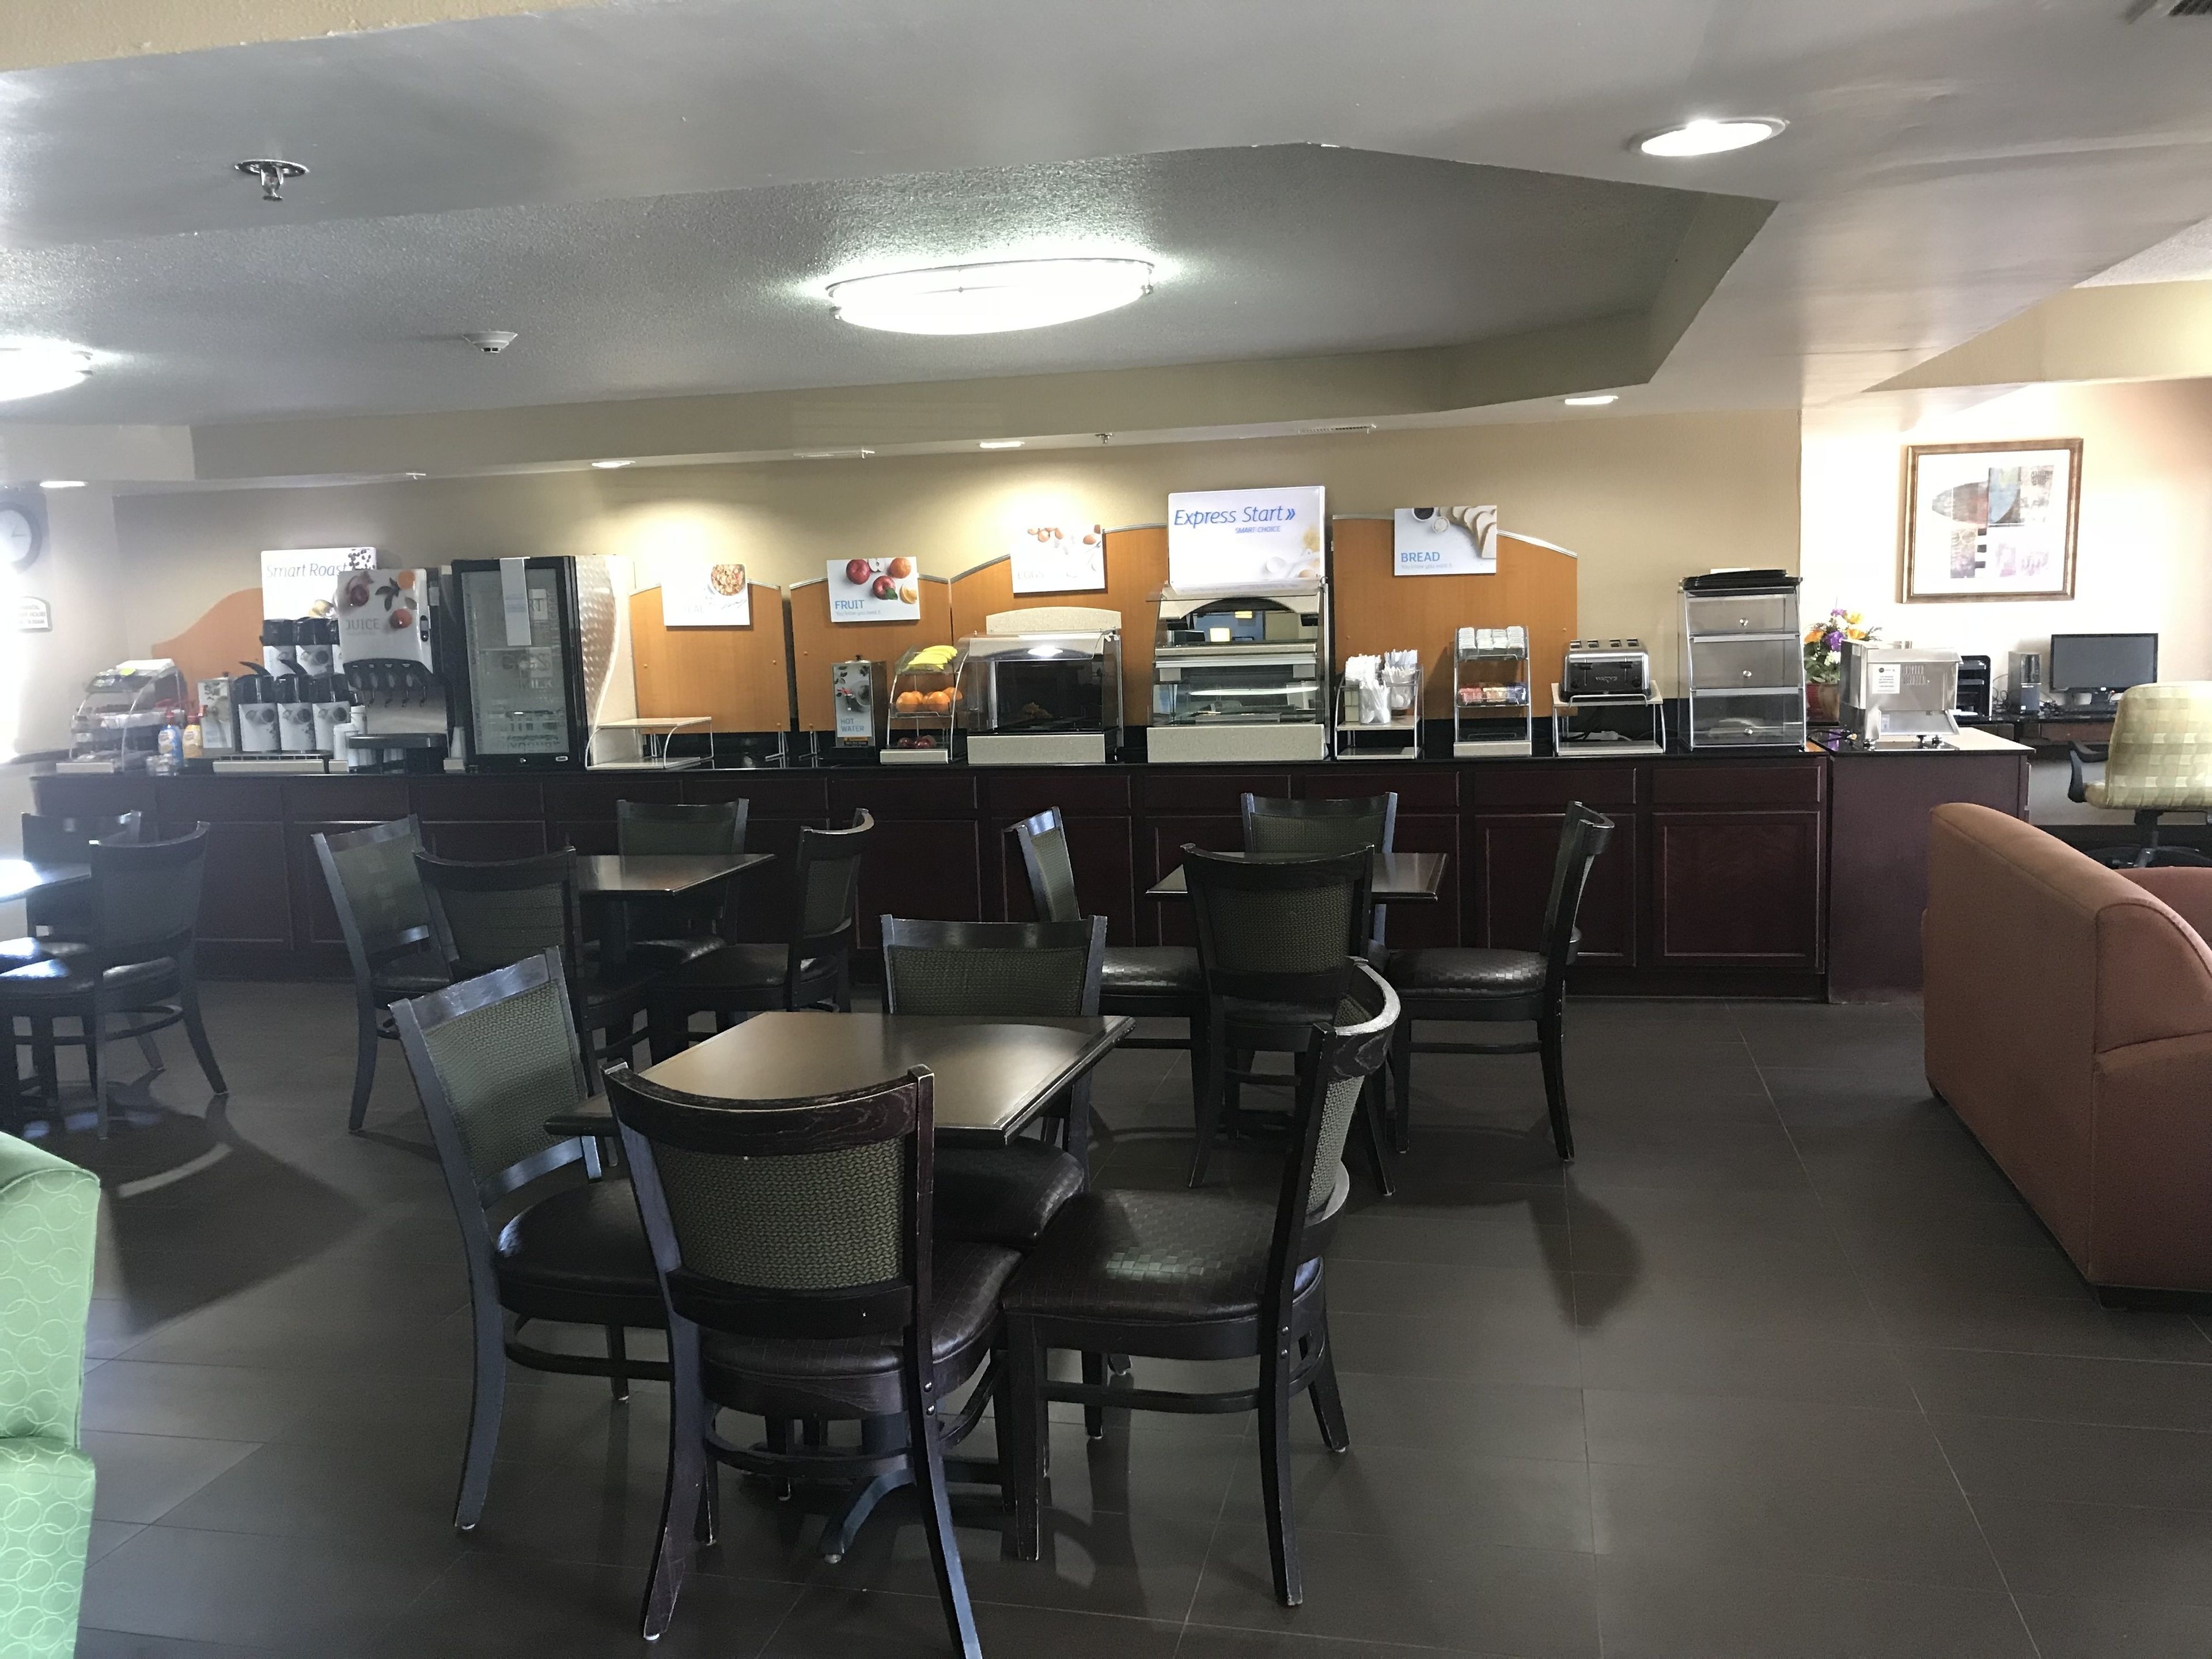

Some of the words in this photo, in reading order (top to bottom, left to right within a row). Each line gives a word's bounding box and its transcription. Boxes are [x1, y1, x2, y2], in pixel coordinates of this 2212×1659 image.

[1174, 510, 1236, 529] Express
[1242, 506, 1283, 522] Start
[1400, 552, 1440, 562] BREAD
[267, 563, 306, 578] Smart
[309, 562, 348, 577] Roast
[834, 600, 865, 609] FRUIT
[346, 618, 380, 630] JUICE
